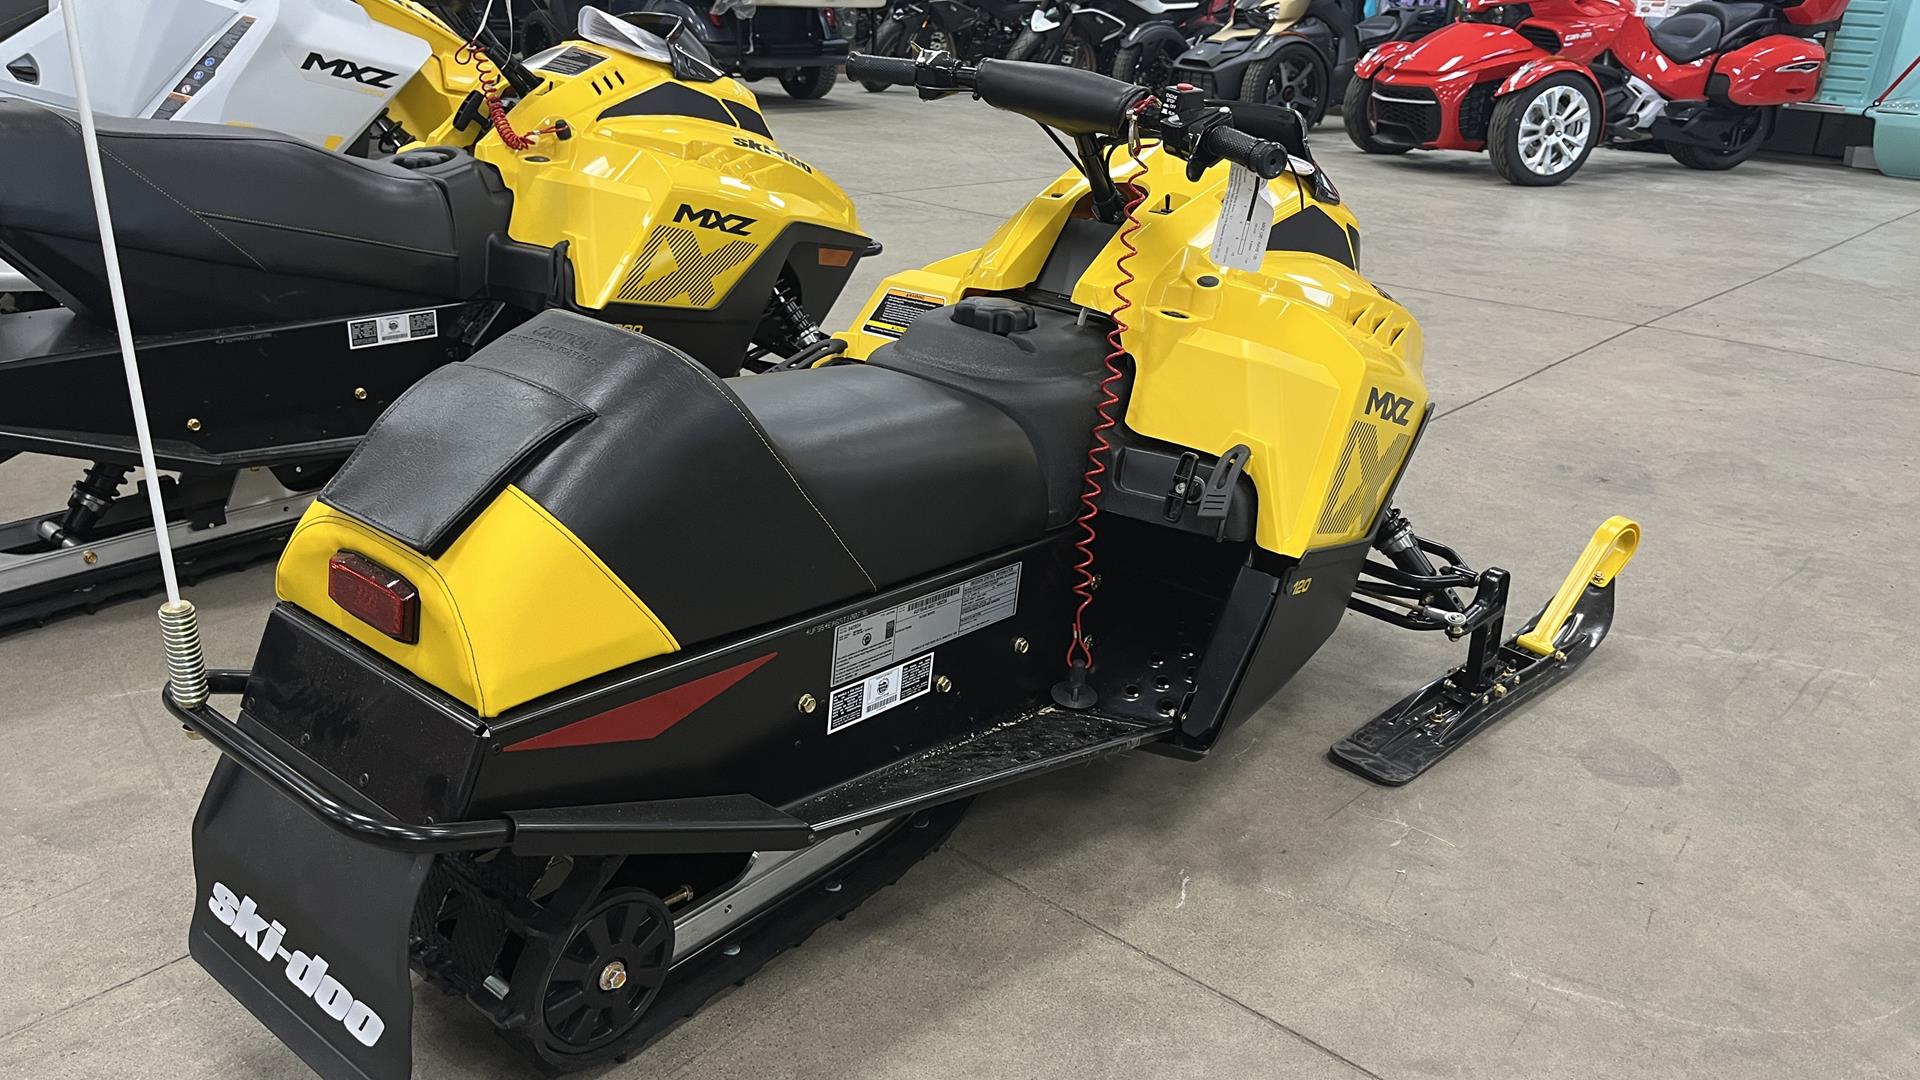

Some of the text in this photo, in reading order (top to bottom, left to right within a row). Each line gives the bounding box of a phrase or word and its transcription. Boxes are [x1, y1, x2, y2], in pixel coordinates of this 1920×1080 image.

[300, 52, 400, 89] MXZ
[672, 203, 758, 237] MXZ
[1364, 386, 1415, 427] MXZ
[1292, 577, 1313, 596] 120
[208, 881, 386, 1047] ski-doo
